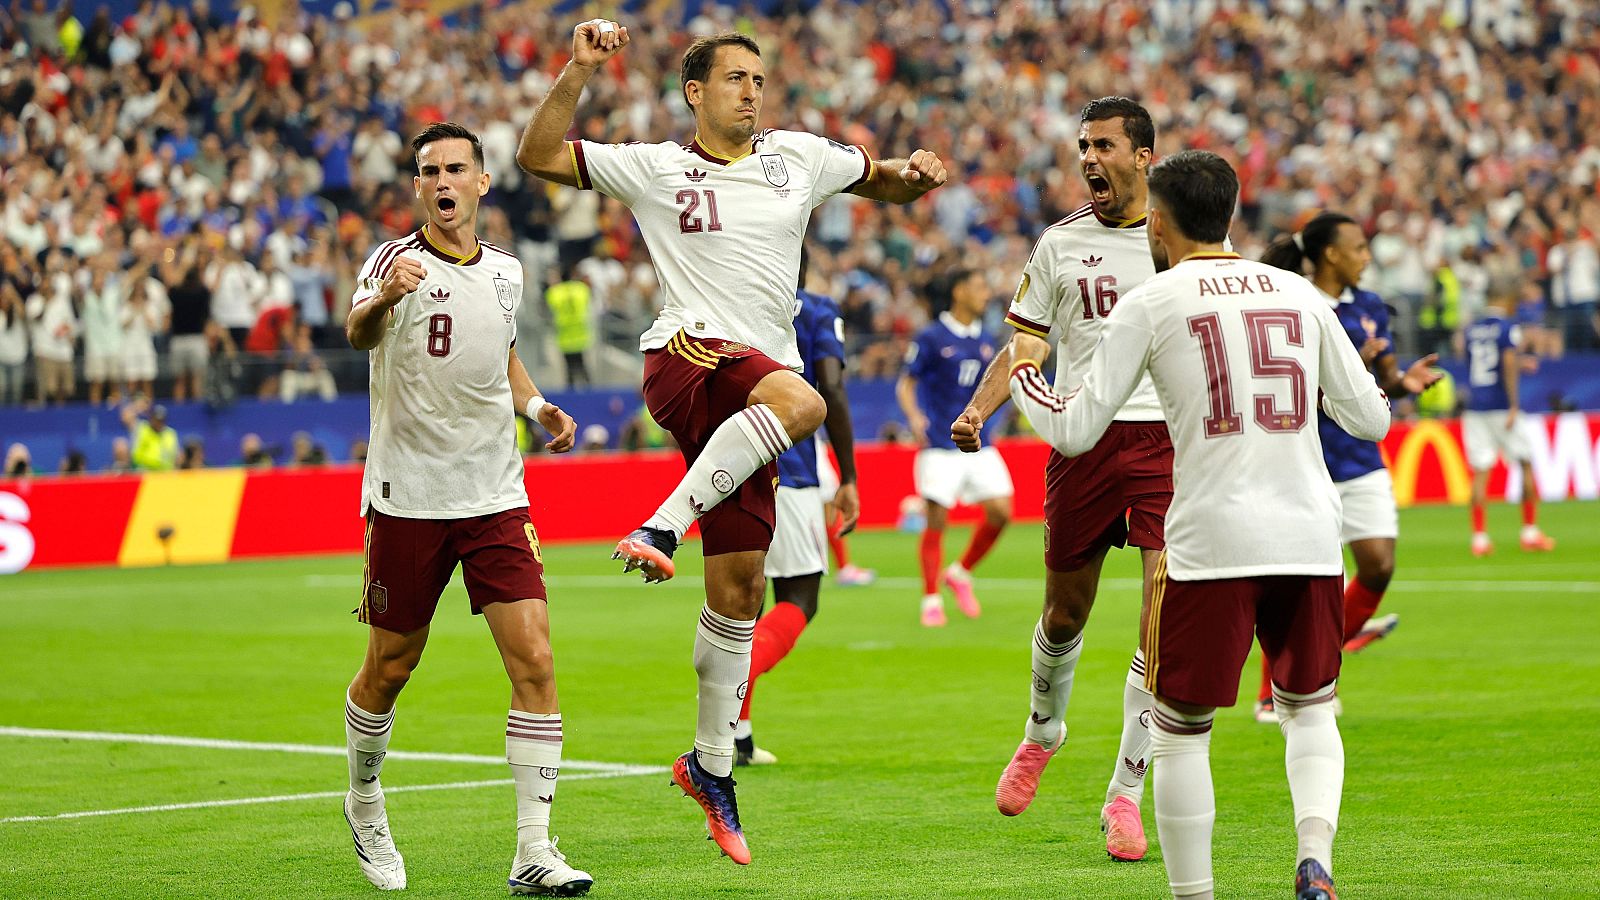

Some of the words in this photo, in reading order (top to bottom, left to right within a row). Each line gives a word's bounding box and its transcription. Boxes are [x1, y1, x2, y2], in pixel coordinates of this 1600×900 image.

[675, 189, 722, 234] 21
[1077, 275, 1118, 320] 16
[1199, 275, 1255, 297] ALEX
[1256, 273, 1280, 293] B.
[426, 313, 453, 358] 8
[1186, 309, 1308, 439] 15
[523, 522, 543, 564] 8
